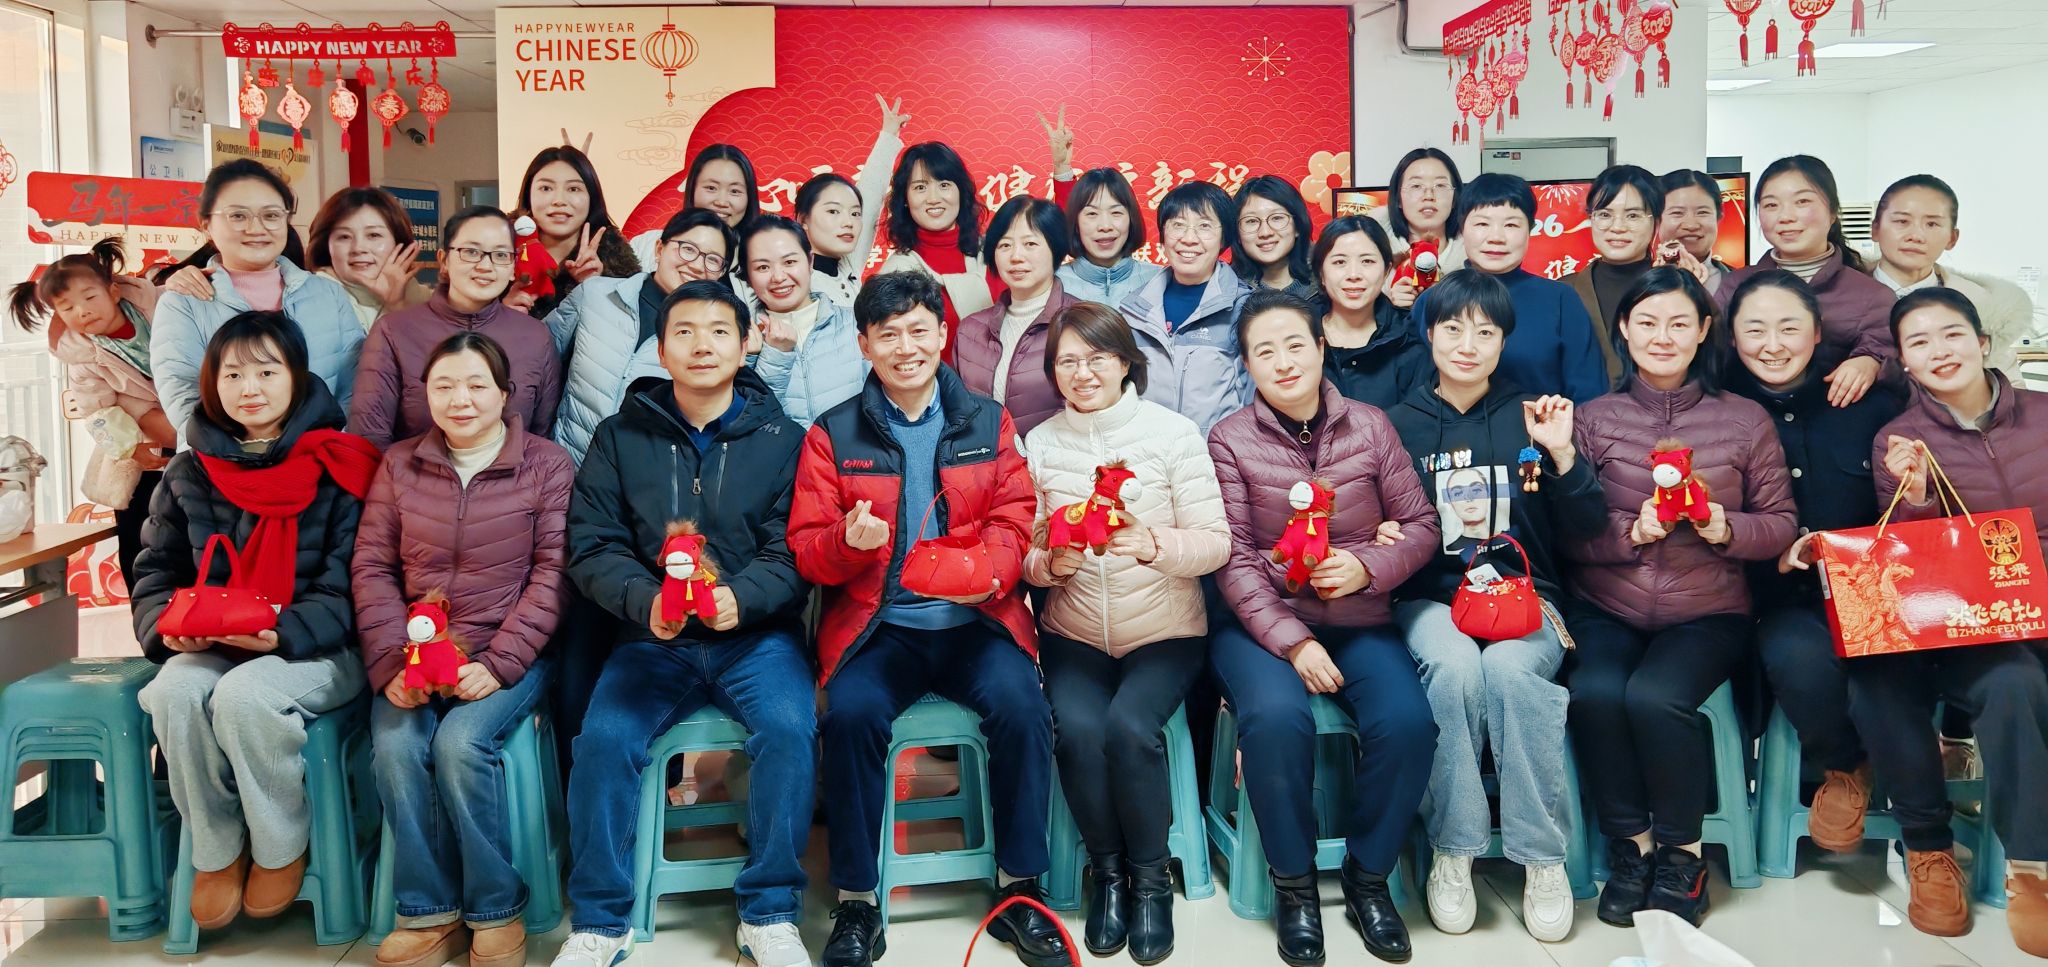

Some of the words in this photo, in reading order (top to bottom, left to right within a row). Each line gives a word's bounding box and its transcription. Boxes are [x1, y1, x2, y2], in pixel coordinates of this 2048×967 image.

[256, 40, 322, 55] HAPPY
[327, 40, 368, 55] NEW
[372, 39, 422, 54] YEAR
[516, 38, 637, 62] CHINESE
[516, 69, 586, 92] YEAR
[139, 232, 180, 245] NEW
[842, 459, 874, 469] CHINA
[1994, 579, 2030, 588] ZHANGFEI
[1959, 621, 2046, 637] ZHANGFEIYOULI
